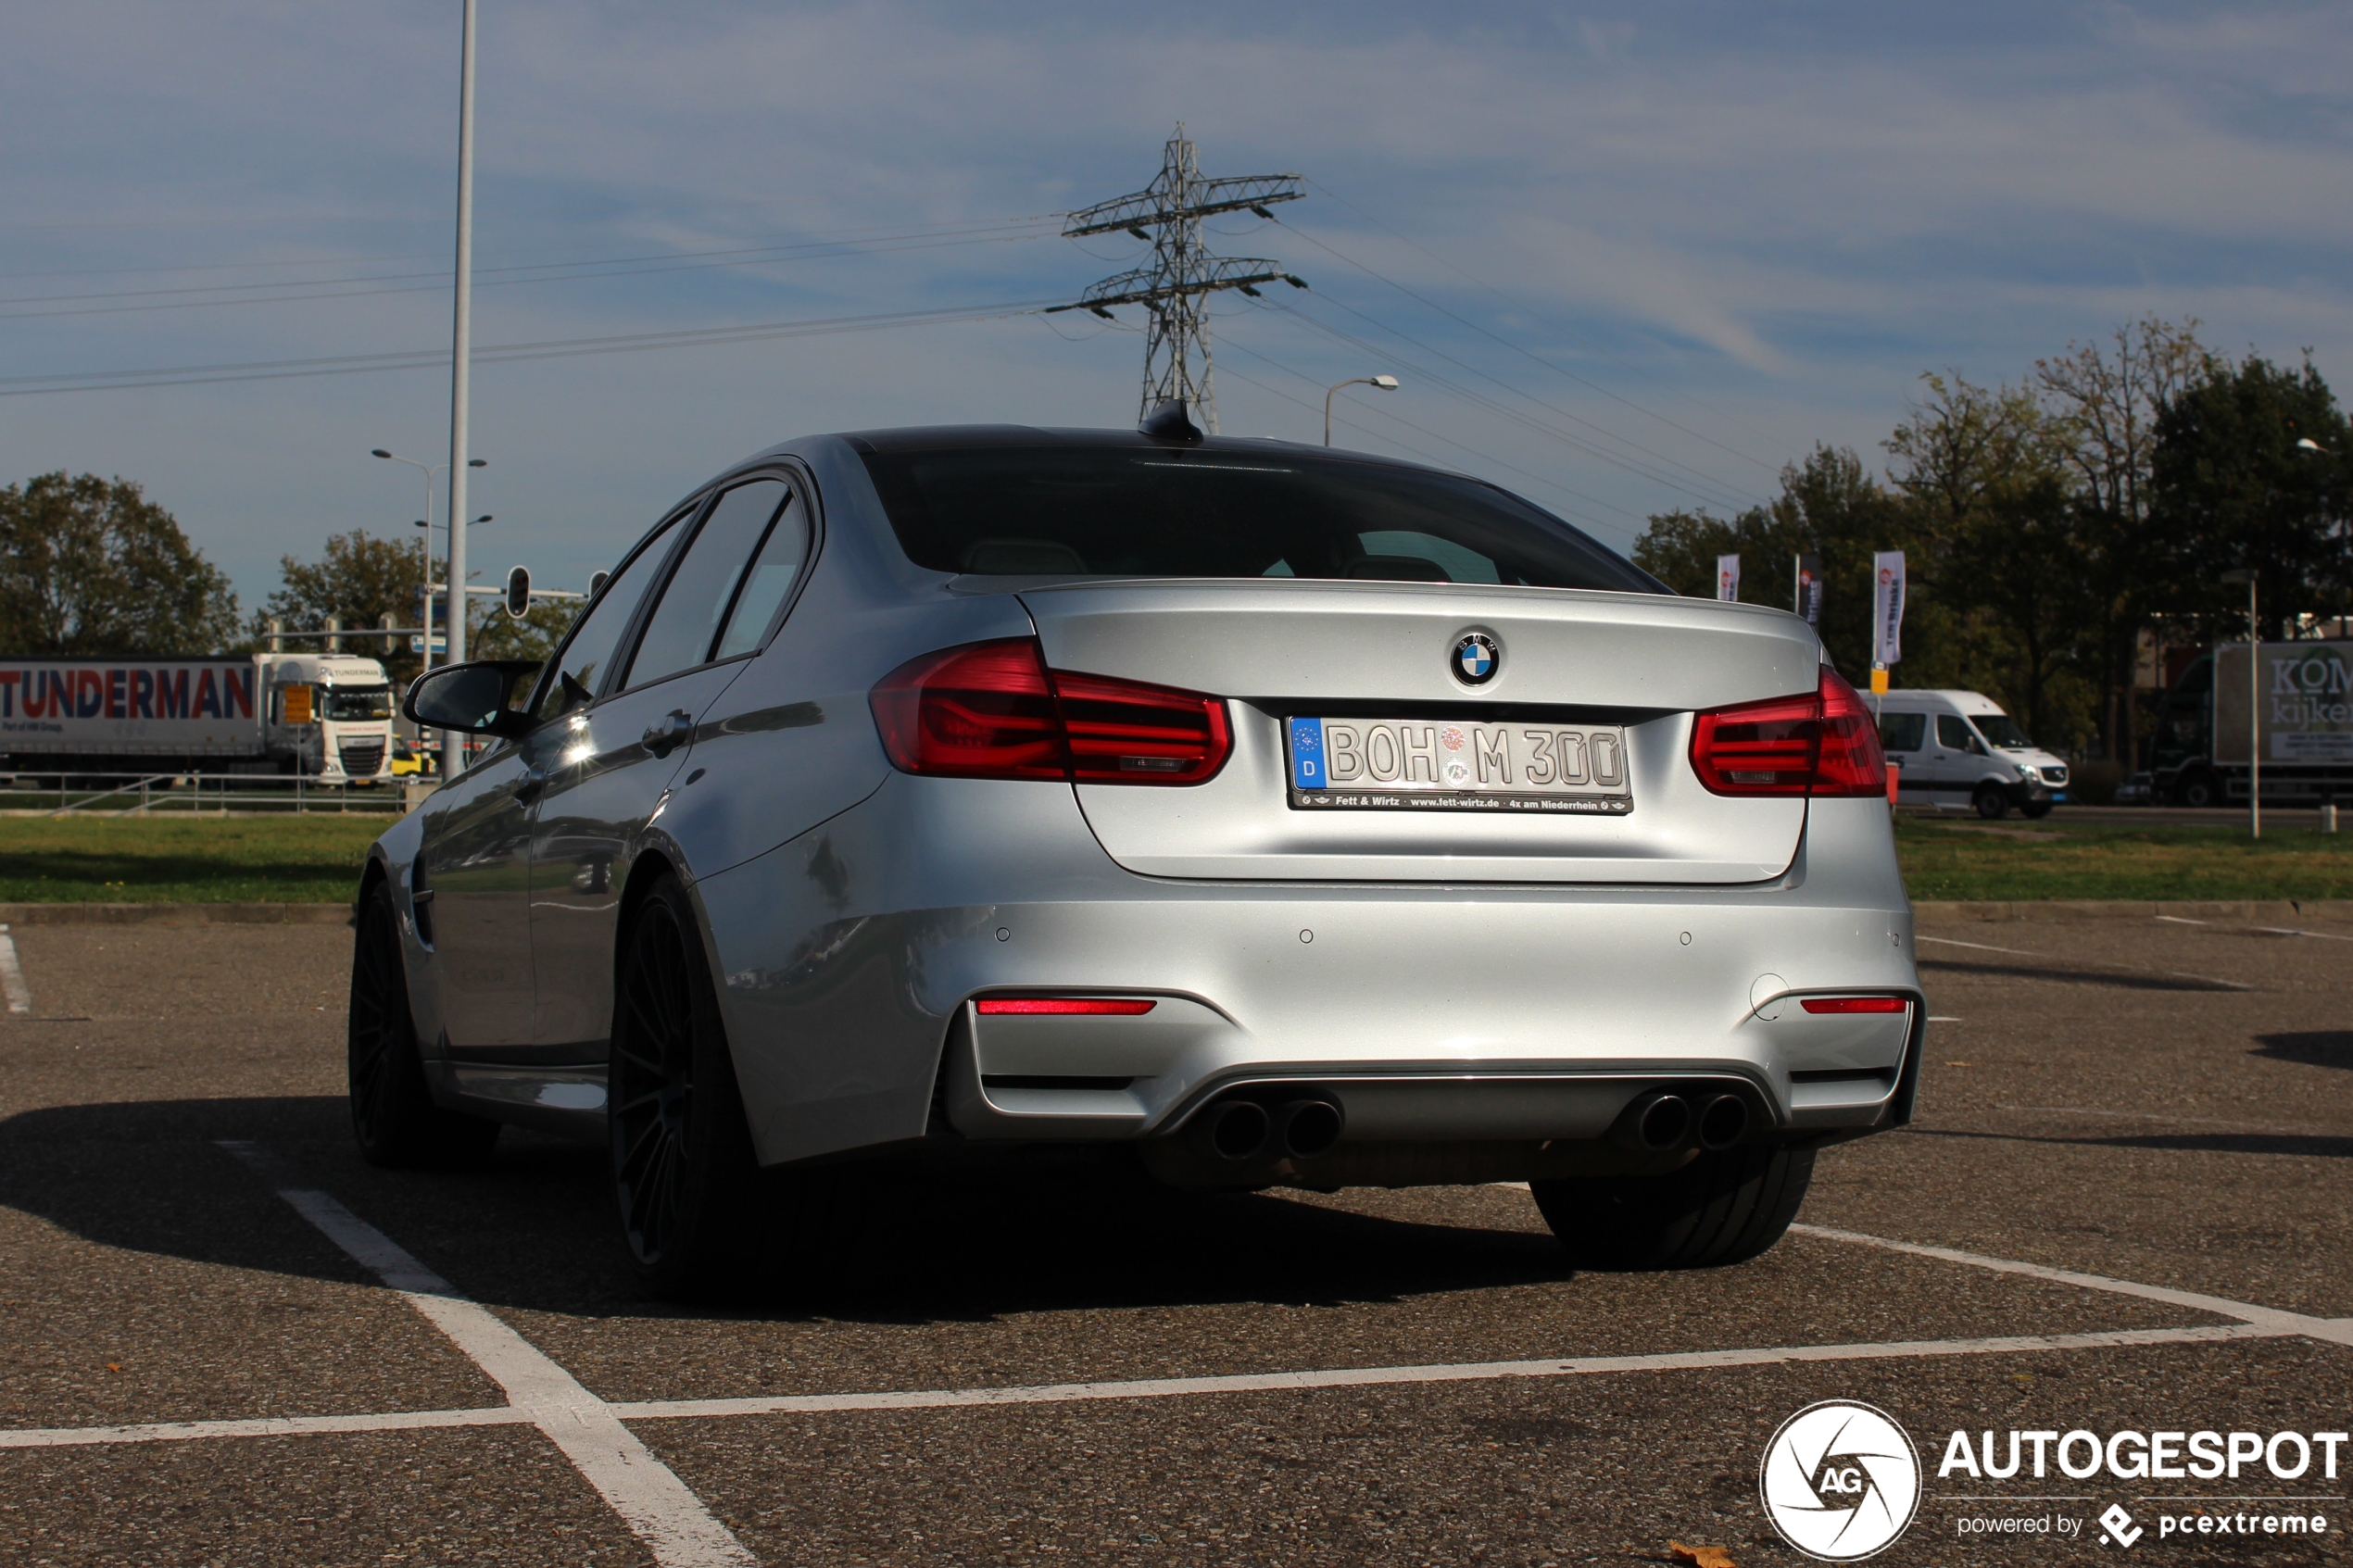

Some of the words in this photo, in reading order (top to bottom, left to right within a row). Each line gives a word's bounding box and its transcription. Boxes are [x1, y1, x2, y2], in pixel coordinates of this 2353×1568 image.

[1458, 633, 1497, 652] BMW
[0, 668, 253, 720] TUNDERMAN
[2271, 697, 2353, 731] kijke
[1303, 760, 1315, 776] D
[1327, 725, 1440, 782] BOH
[1474, 728, 1512, 784] M
[1524, 731, 1623, 786] 300
[1335, 796, 1358, 806] Fett
[1360, 797, 1369, 806] &
[1372, 797, 1401, 806] Wirtz
[1410, 797, 1500, 809] www.fett-wirtz.de
[1509, 799, 1521, 809] 4x
[1523, 801, 1539, 809] am
[1541, 799, 1598, 810] Niederrhein
